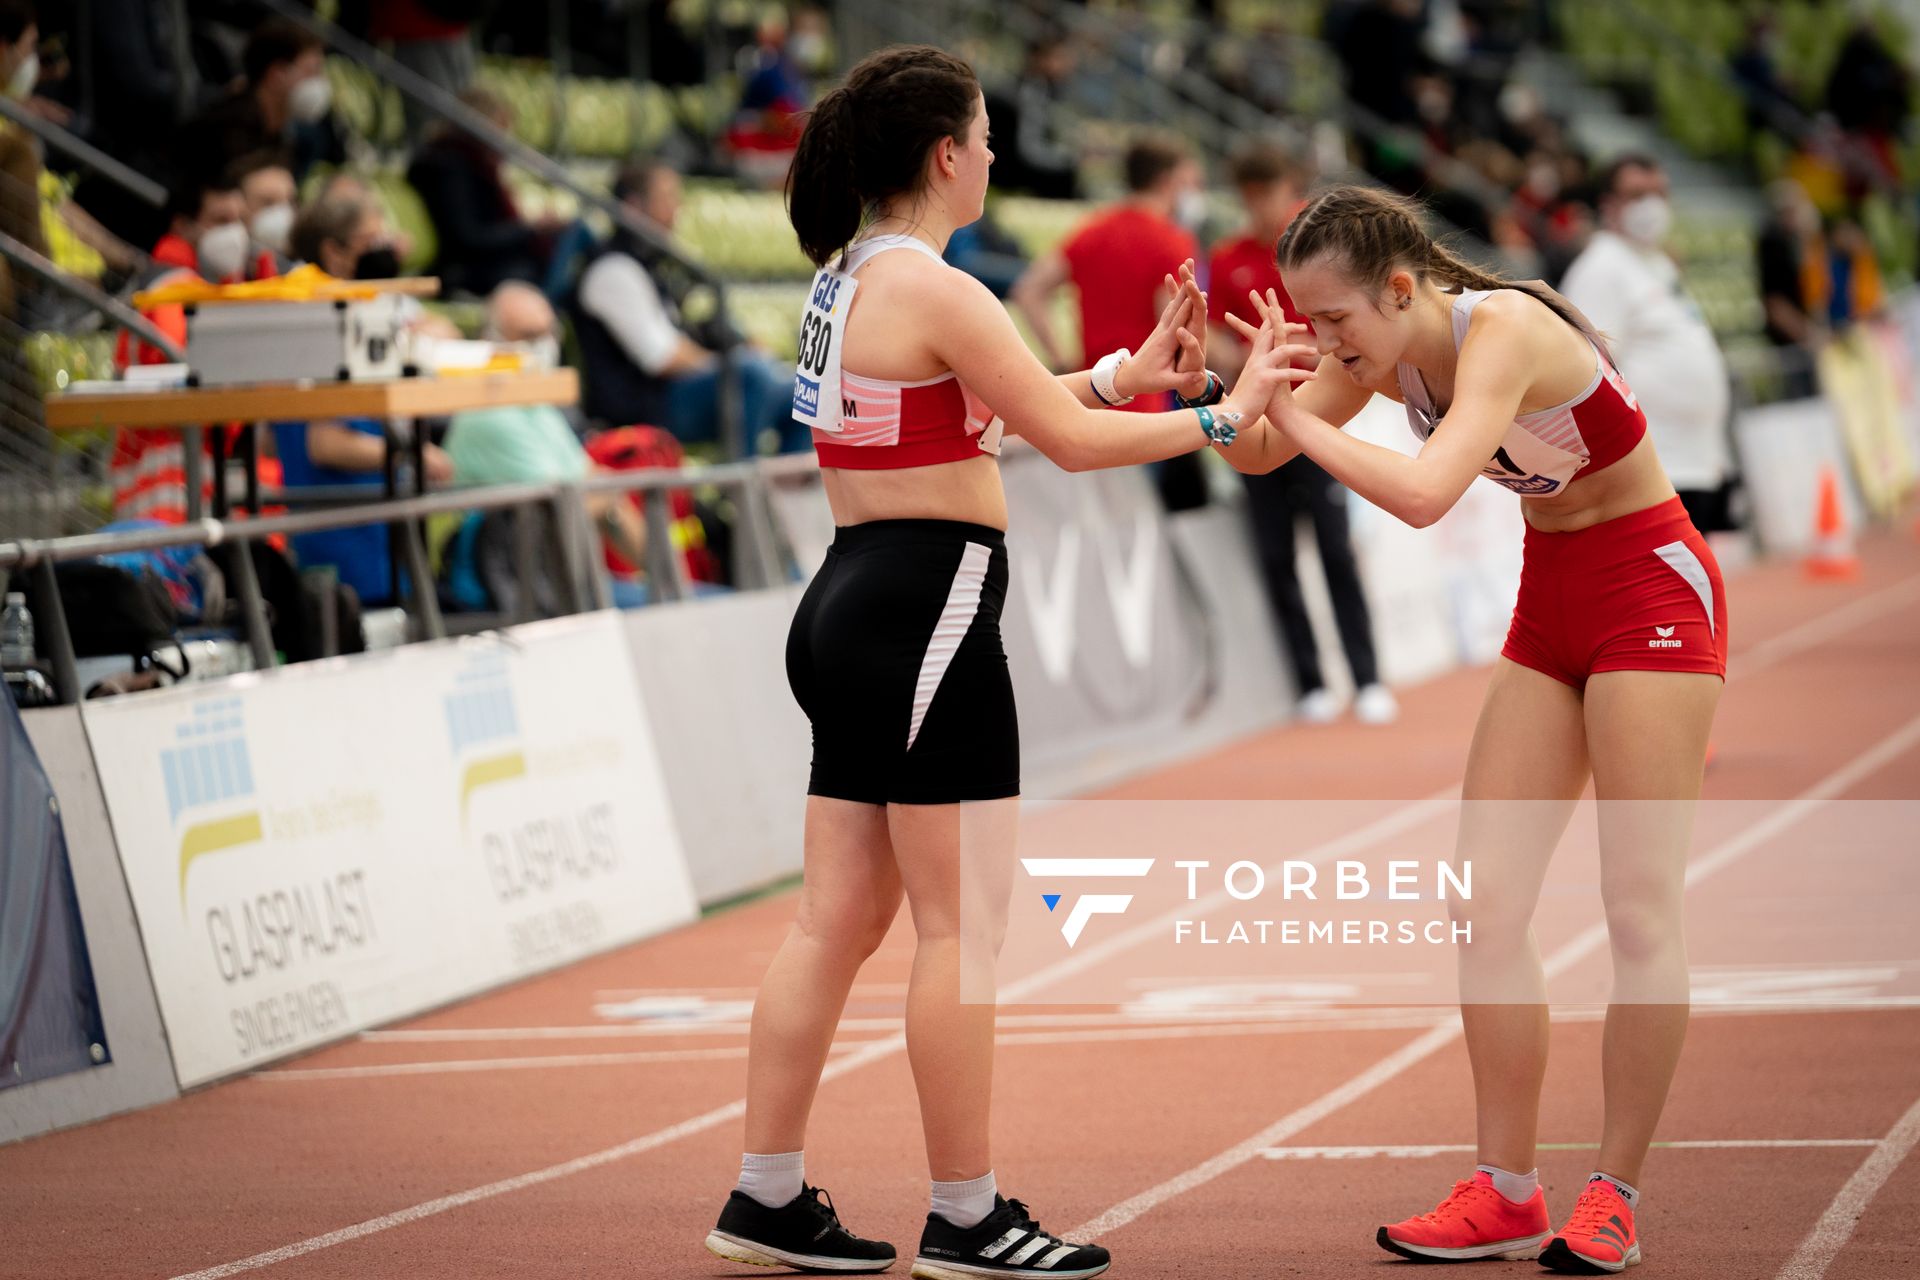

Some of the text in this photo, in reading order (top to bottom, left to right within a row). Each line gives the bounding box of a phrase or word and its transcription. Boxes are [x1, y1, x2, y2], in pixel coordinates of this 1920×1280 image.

[798, 310, 832, 376] 630
[798, 383, 818, 405] PLAN
[1648, 638, 1682, 648] erima
[206, 868, 377, 985] GLASPALAST
